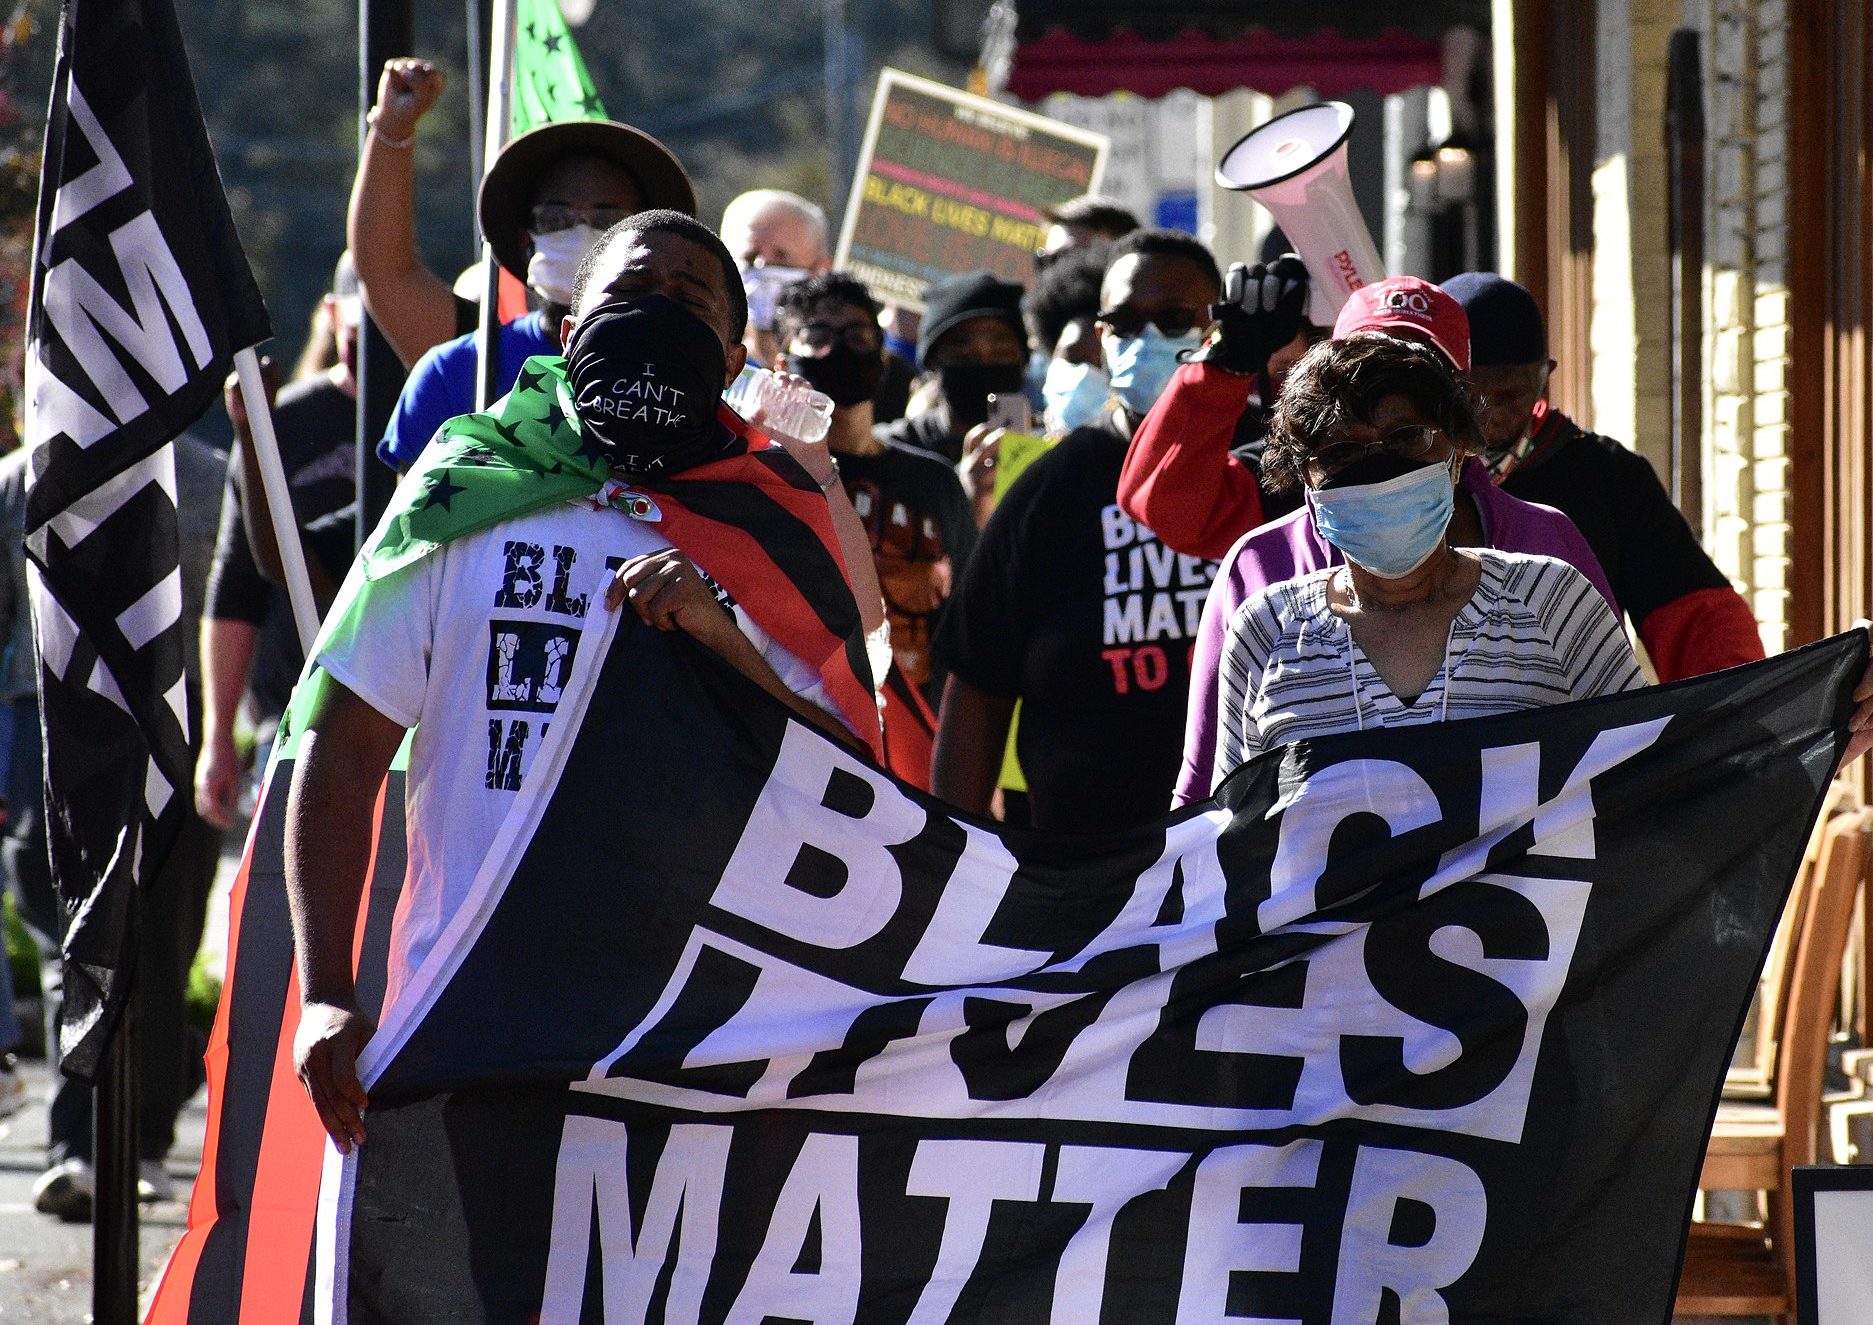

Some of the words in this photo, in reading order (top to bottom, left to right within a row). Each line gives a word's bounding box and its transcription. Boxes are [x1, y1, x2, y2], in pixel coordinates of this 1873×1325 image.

[862, 174, 931, 218] BLACK
[930, 197, 993, 237] LIVES
[612, 378, 685, 406] CAN'T
[642, 362, 656, 377] I
[1103, 588, 1208, 645] MAT
[1102, 643, 1169, 695] TO
[709, 714, 1675, 986] BLACK
[603, 881, 1551, 1111] LIVES
[538, 1114, 1488, 1325] MATTER
